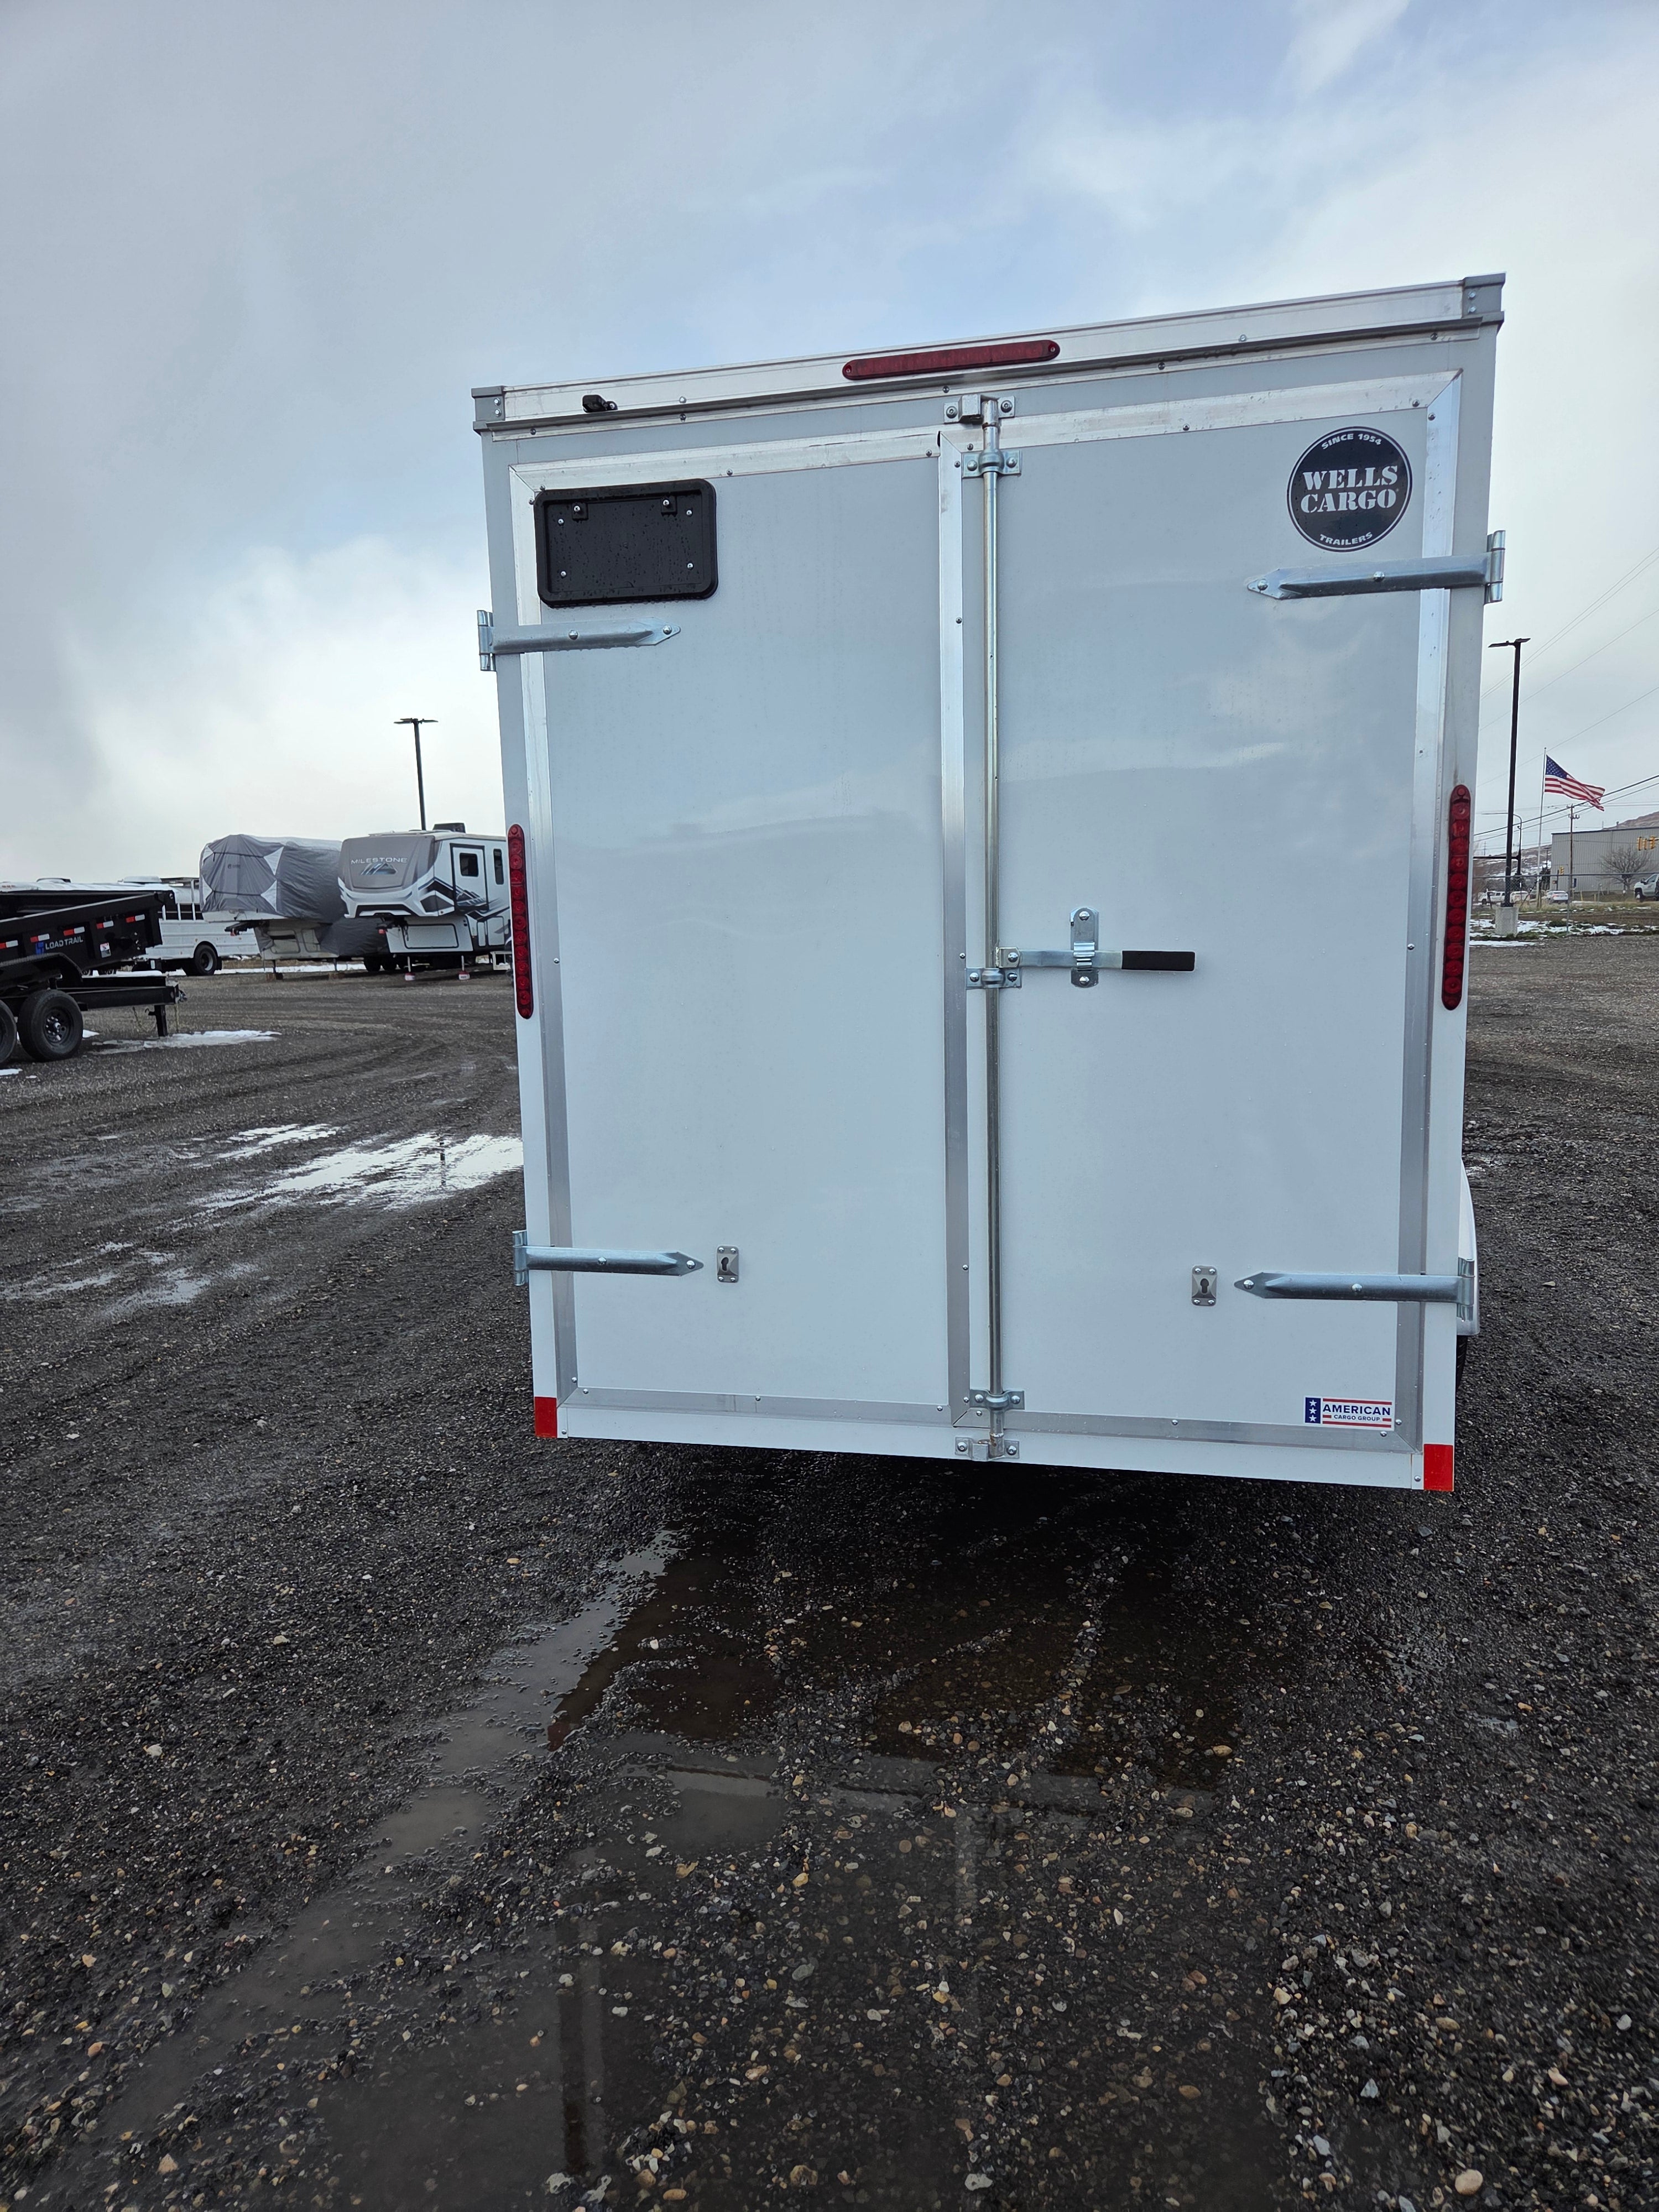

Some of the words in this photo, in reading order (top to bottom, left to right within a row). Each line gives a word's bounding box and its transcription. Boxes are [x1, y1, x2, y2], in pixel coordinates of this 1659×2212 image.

[1321, 433, 1354, 450] SINCE
[1358, 433, 1382, 445] 1954
[1303, 465, 1398, 491] WELLS
[1301, 489, 1397, 513] CARGO
[1319, 531, 1373, 545] TRAILERS
[45, 940, 64, 950] LOAD
[65, 936, 84, 946] TRAIL
[1322, 1404, 1391, 1416] AMERICAN
